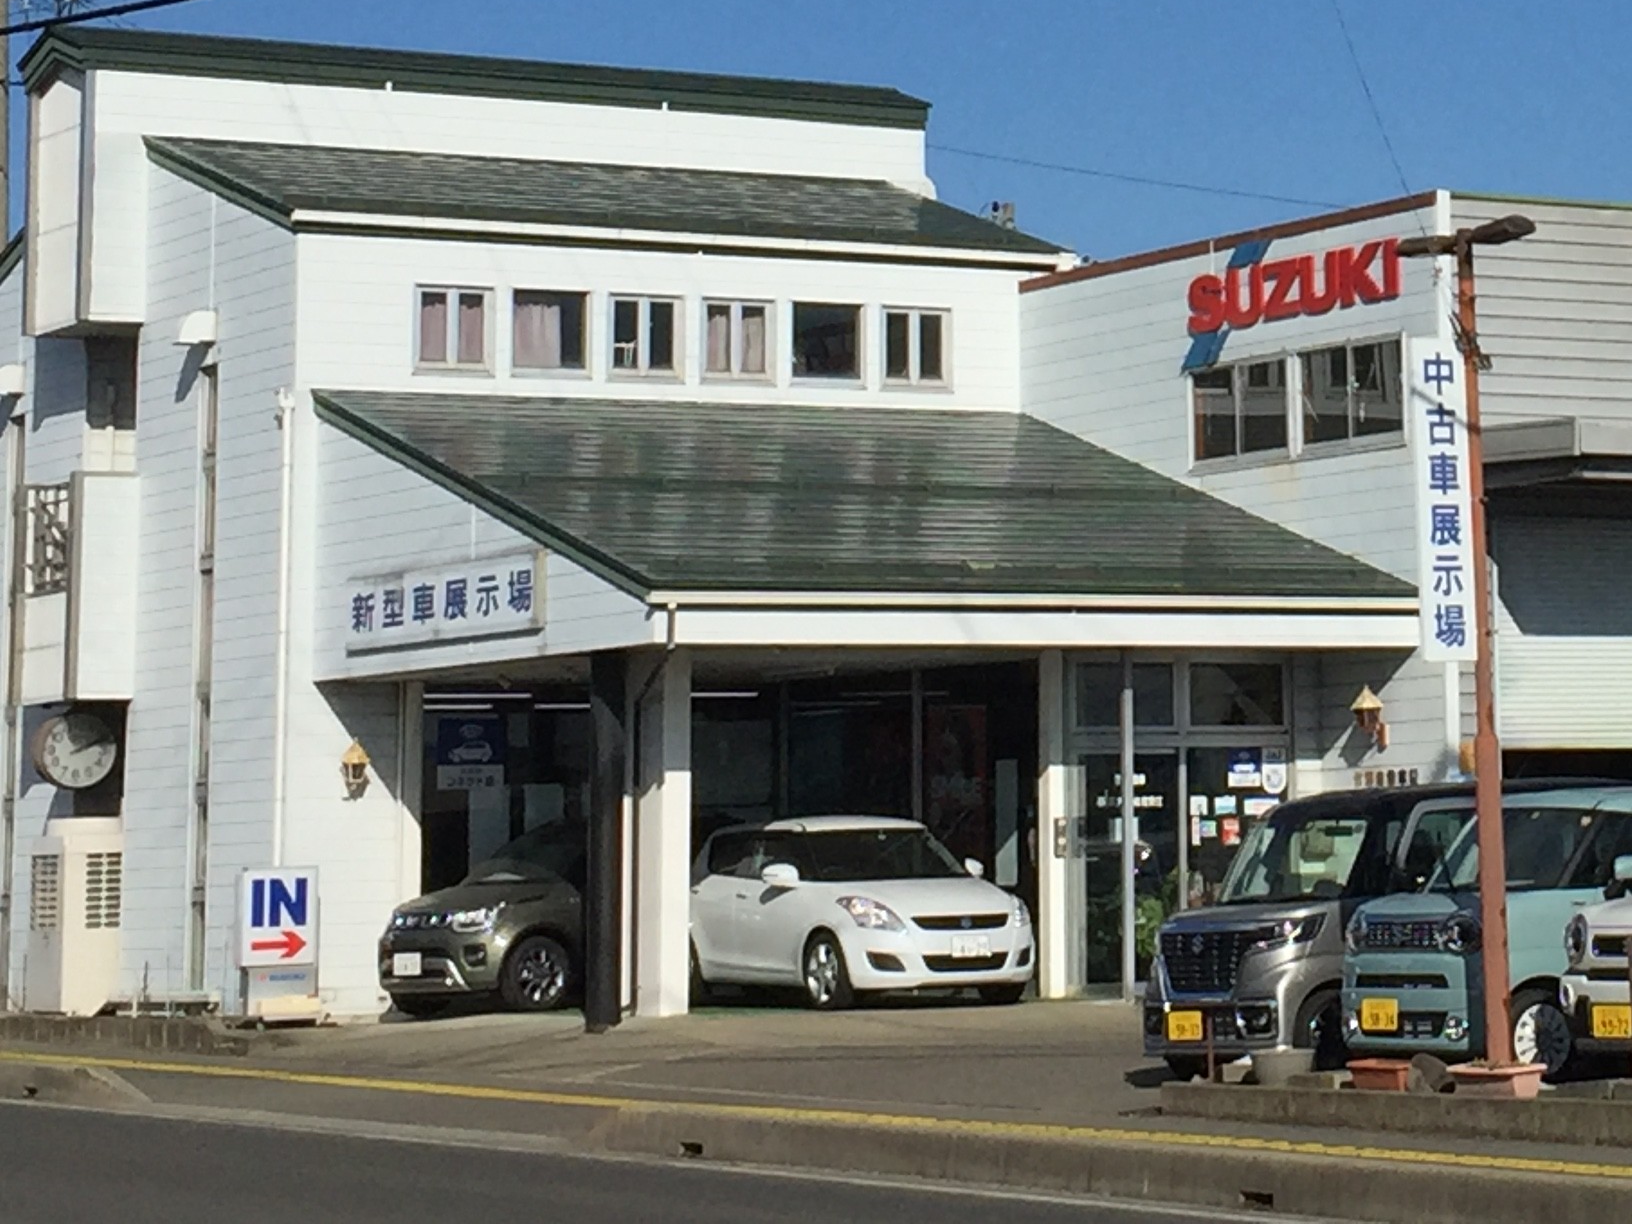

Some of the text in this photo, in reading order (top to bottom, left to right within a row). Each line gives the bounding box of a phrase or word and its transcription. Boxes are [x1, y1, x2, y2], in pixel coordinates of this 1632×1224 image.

[1187, 238, 1399, 333] SUZUKI
[1422, 352, 1466, 648] 中古車展示場
[351, 569, 533, 633] 新型車展示場
[252, 878, 307, 927] IN
